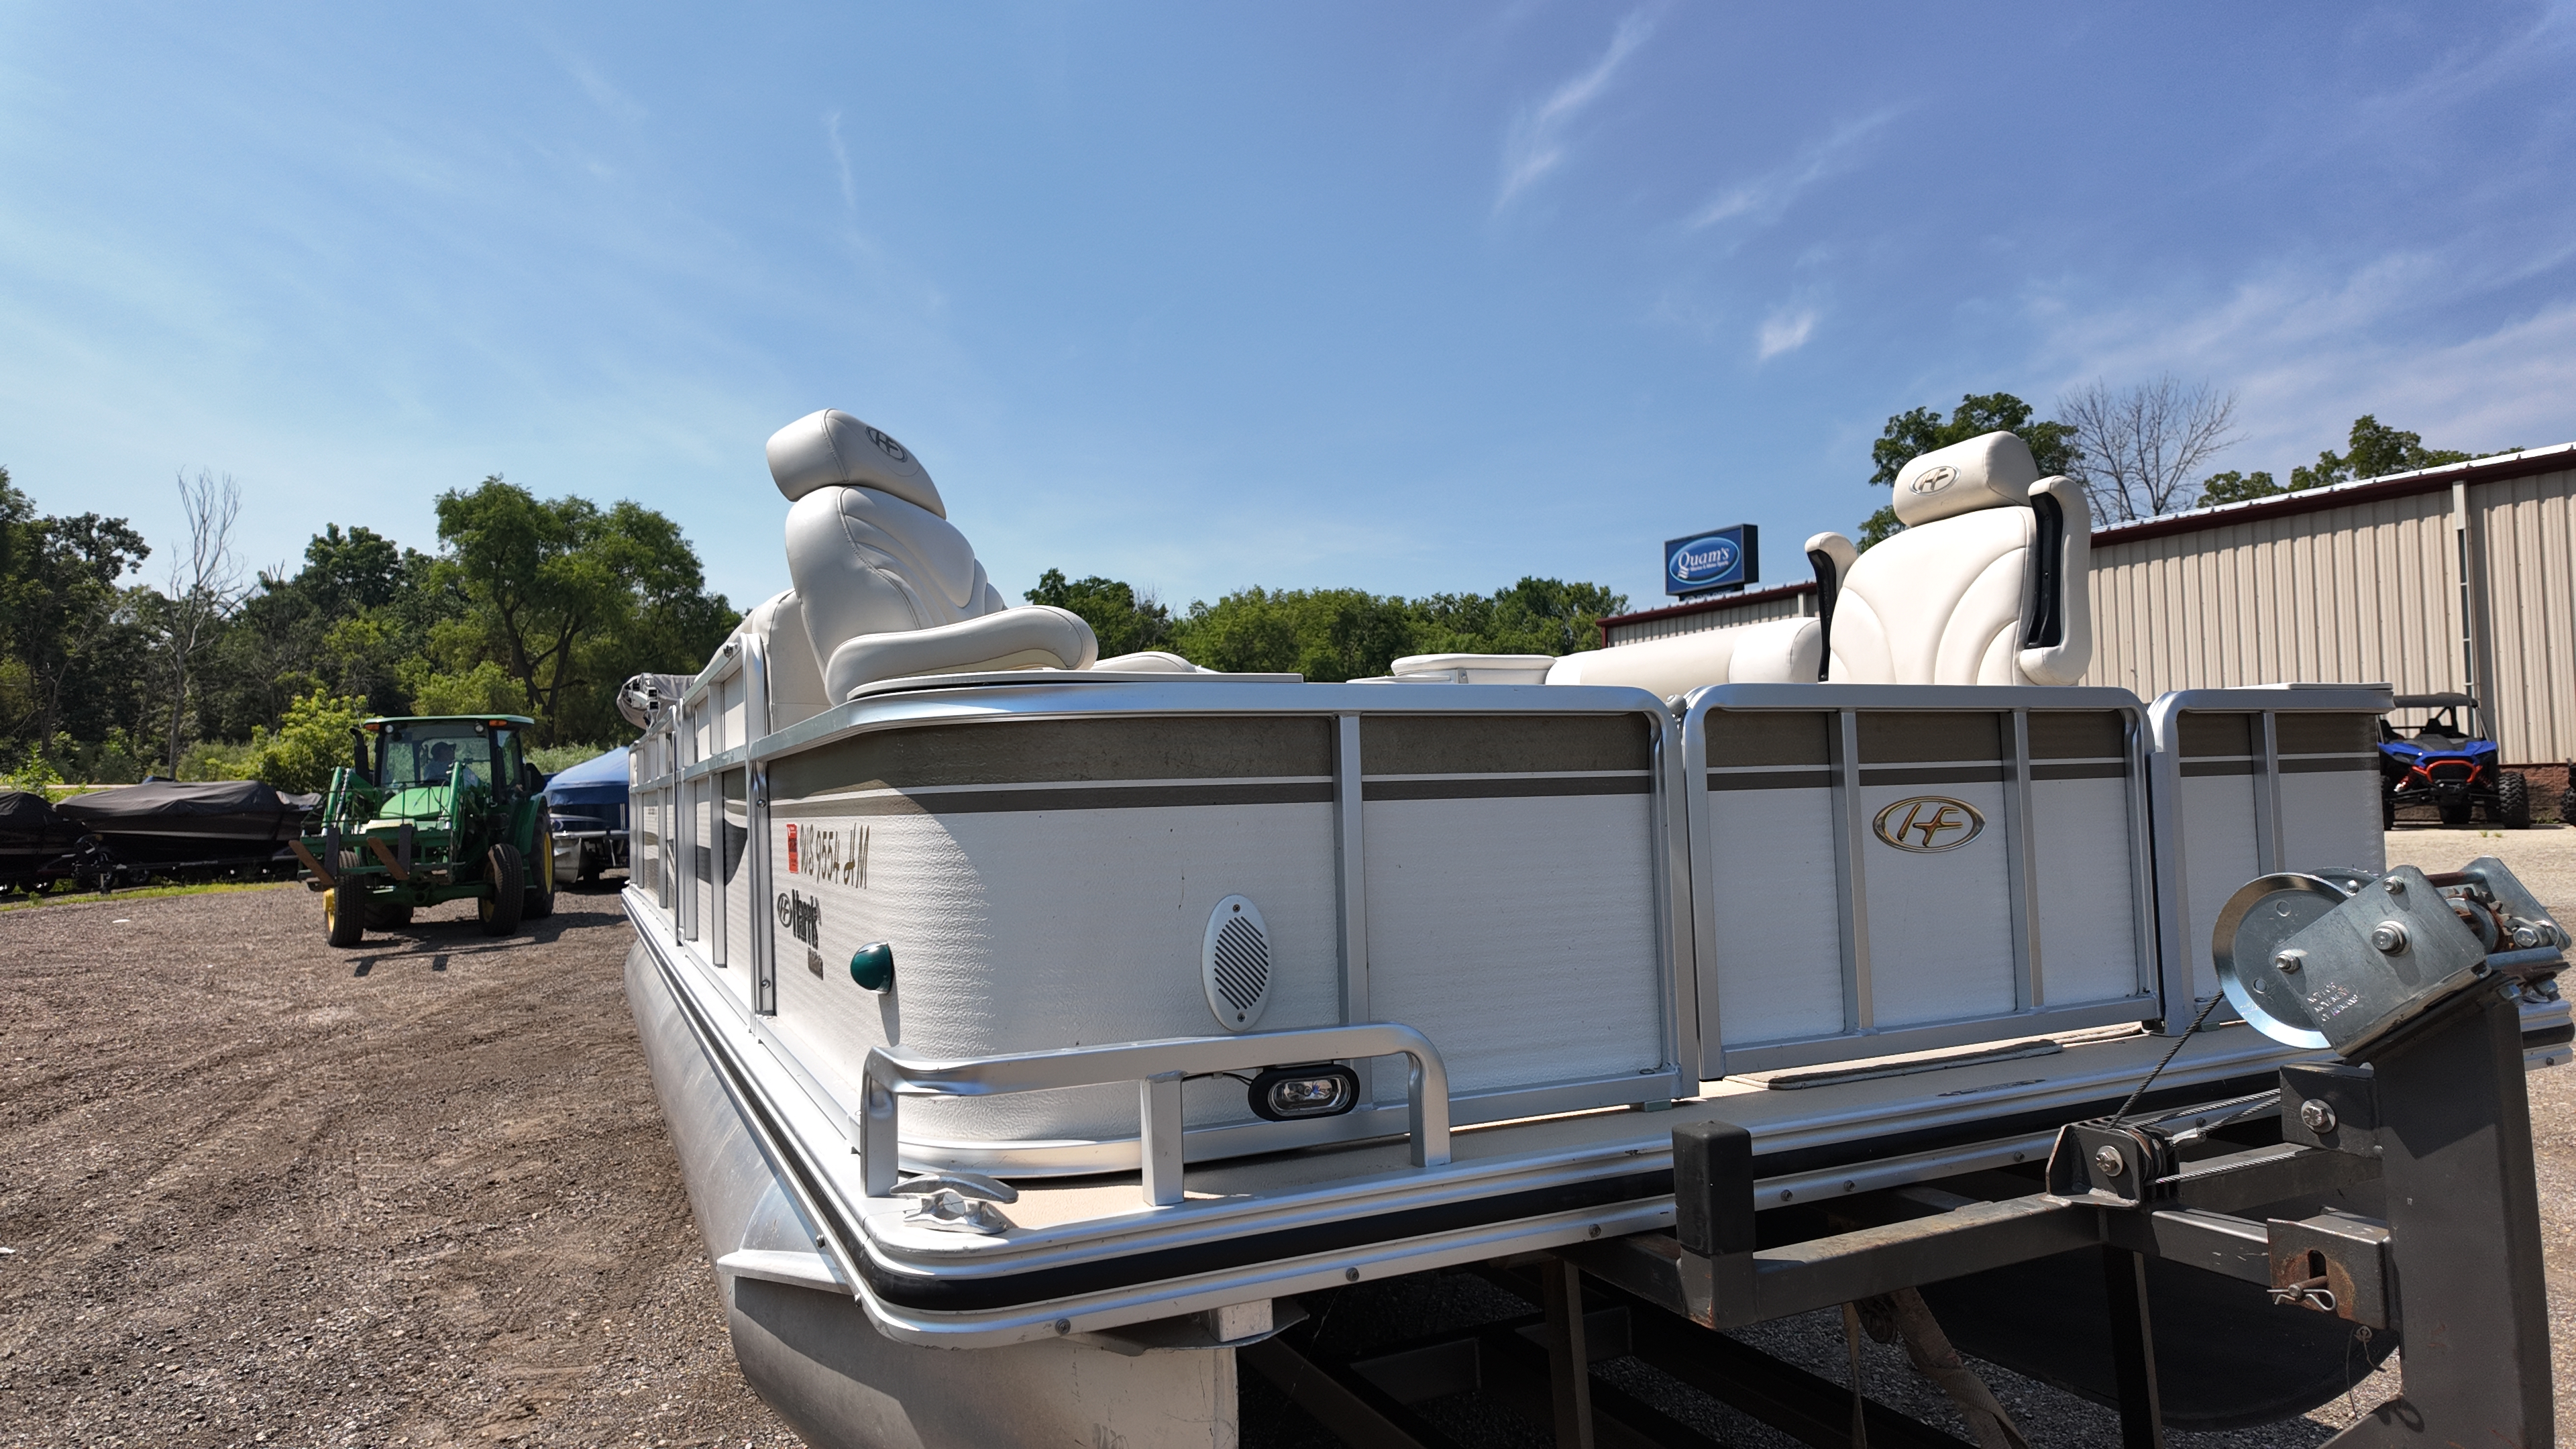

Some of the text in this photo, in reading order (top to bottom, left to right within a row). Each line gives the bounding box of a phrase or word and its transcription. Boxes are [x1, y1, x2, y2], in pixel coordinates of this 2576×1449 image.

[1678, 547, 1730, 578] Quam's
[800, 823, 814, 876] WS
[816, 830, 841, 885] 9554
[792, 888, 819, 951] Harris
